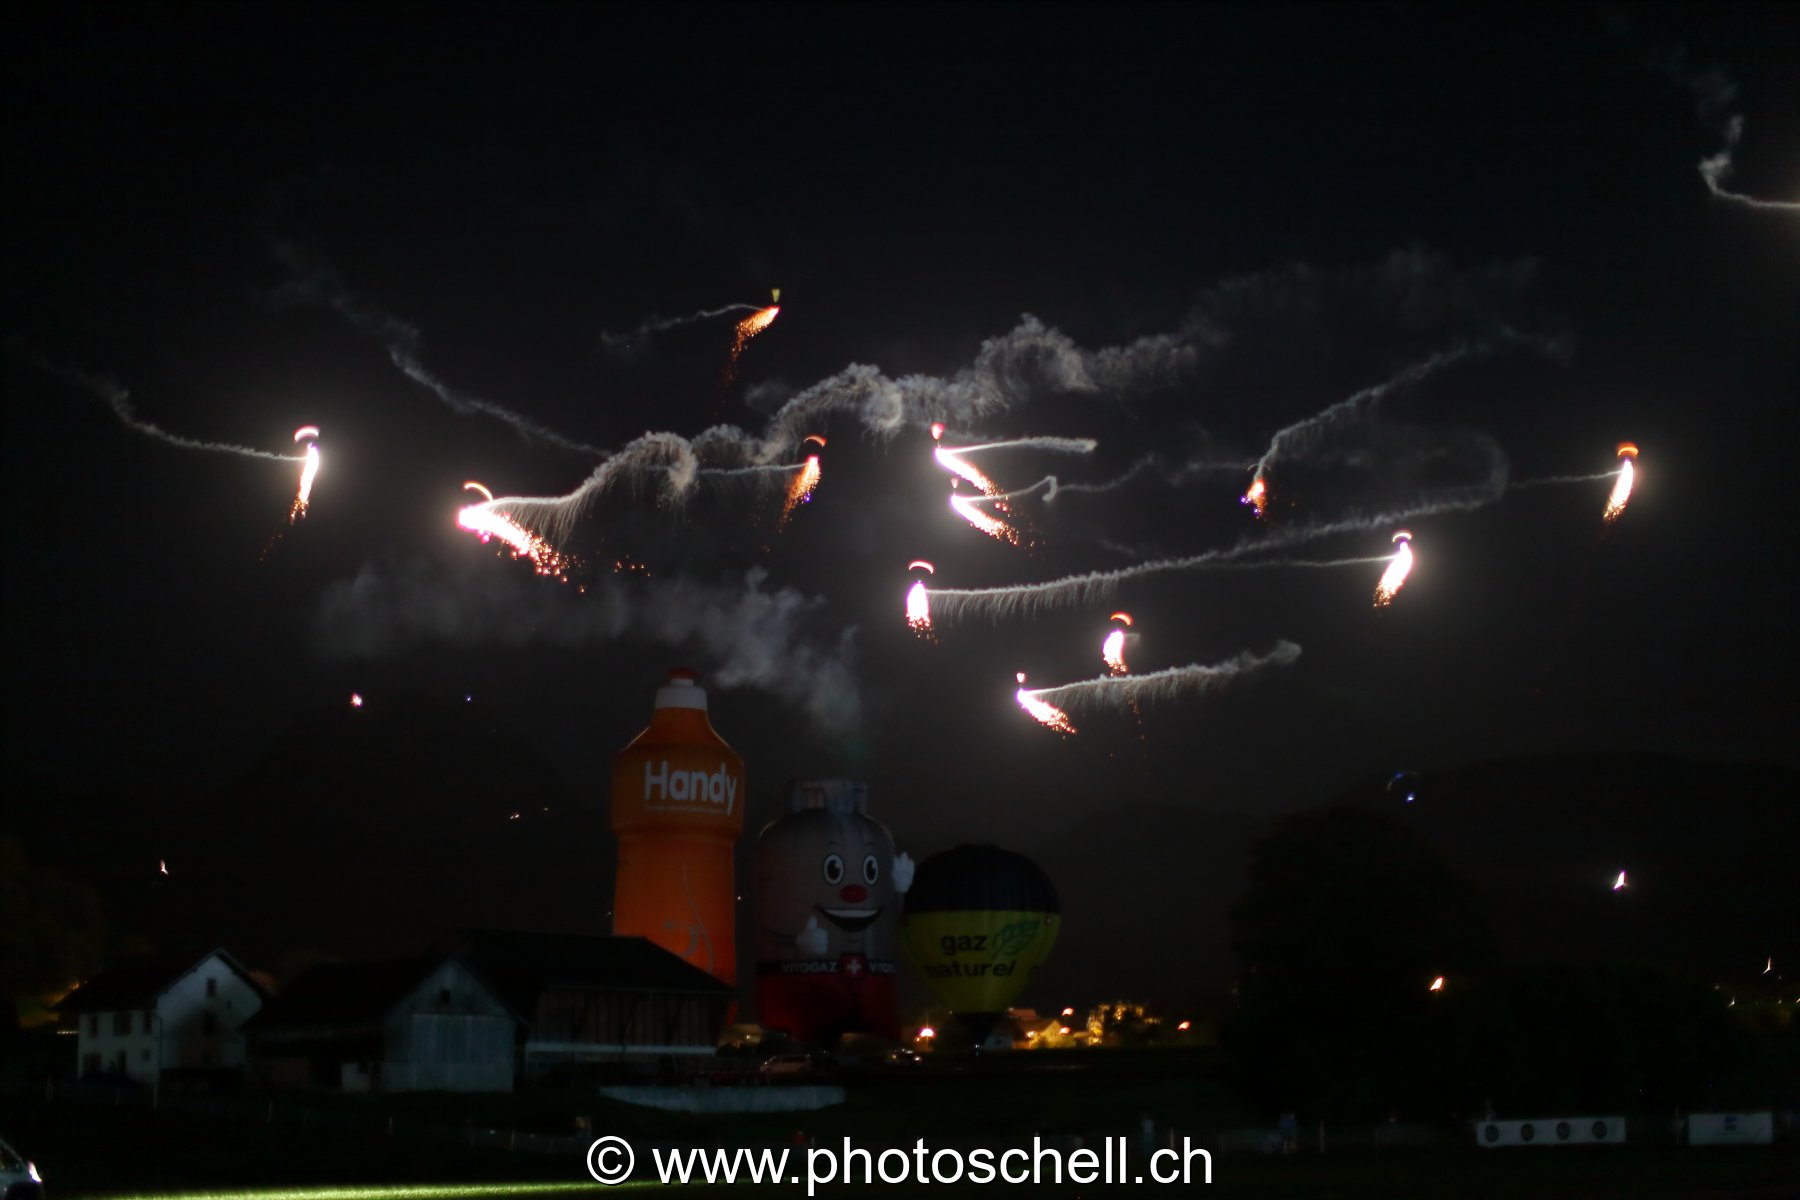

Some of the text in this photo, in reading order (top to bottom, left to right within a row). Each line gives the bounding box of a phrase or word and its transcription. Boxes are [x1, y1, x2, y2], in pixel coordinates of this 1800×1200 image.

[644, 760, 738, 816] Handy
[941, 935, 988, 956] gaz
[782, 961, 838, 974] VITOGAZ
[926, 960, 1017, 978] naturel
